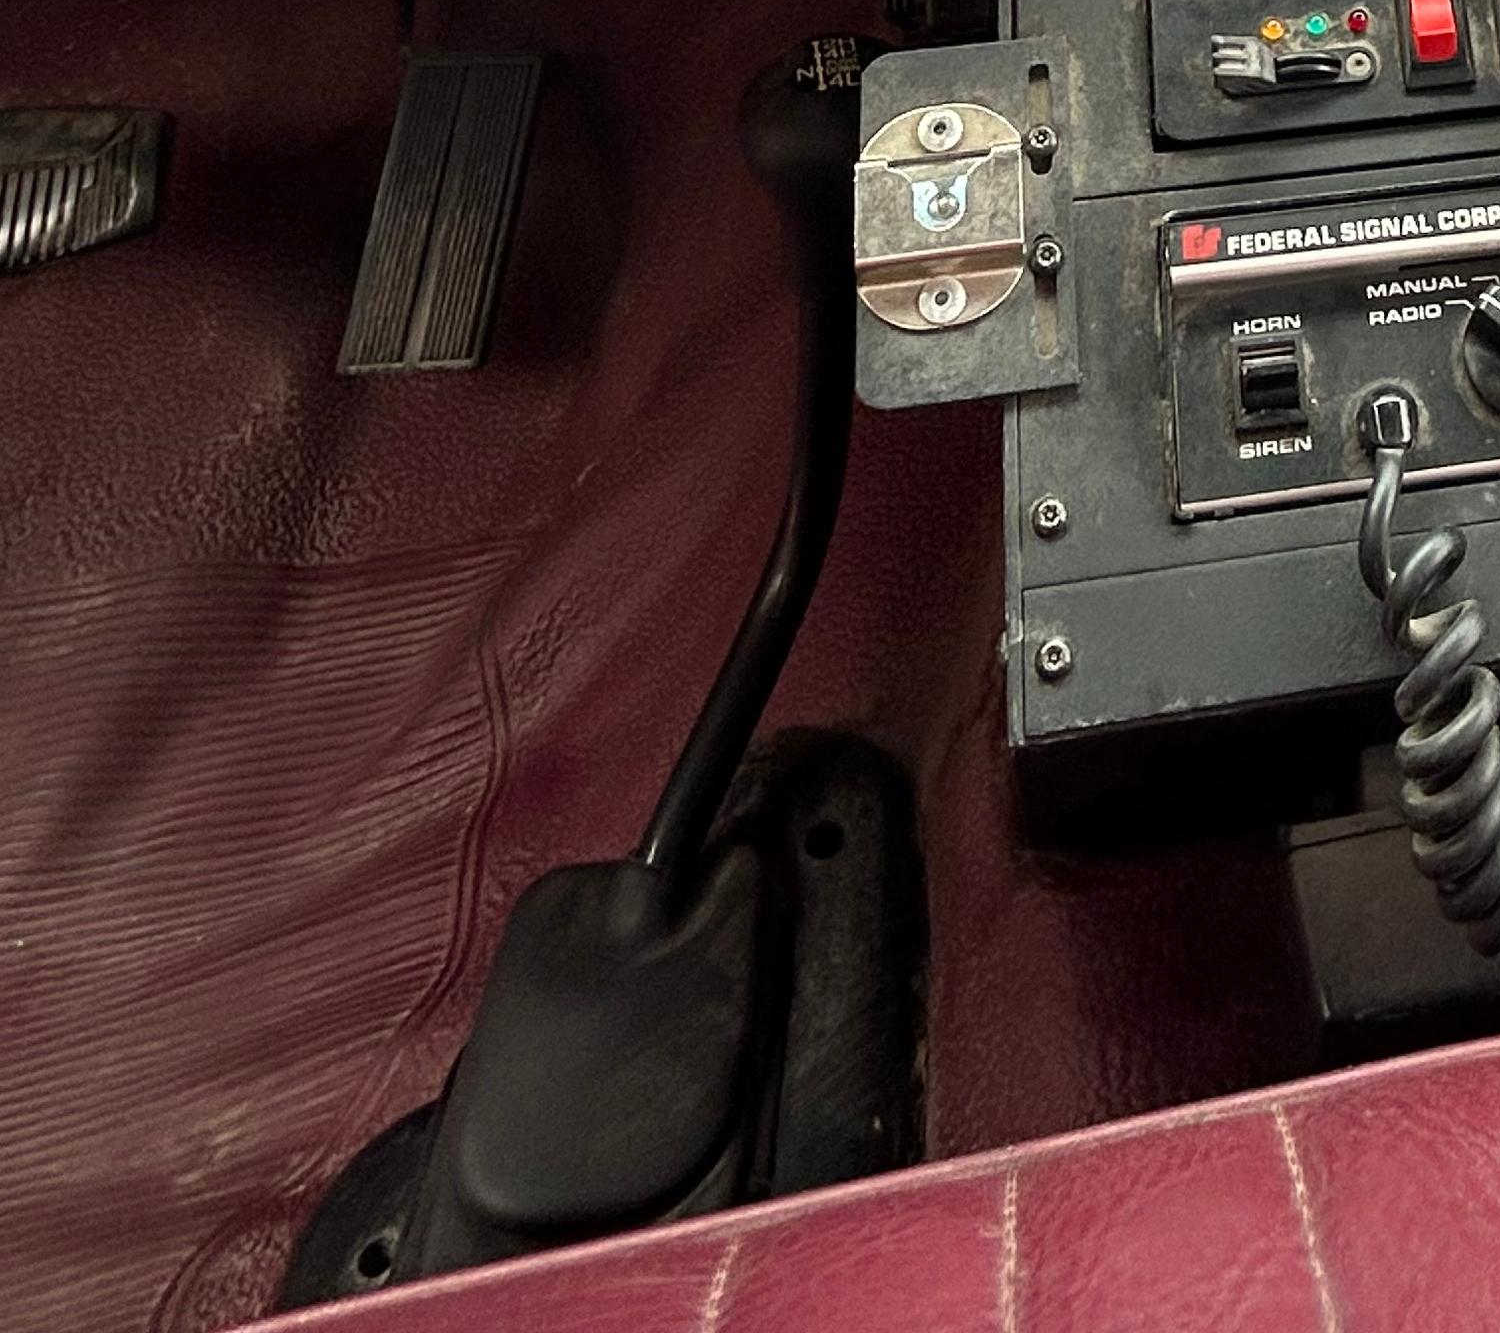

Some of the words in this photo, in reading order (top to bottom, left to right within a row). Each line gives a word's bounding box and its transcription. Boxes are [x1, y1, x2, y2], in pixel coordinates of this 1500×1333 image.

[796, 65, 815, 82] N
[1226, 222, 1336, 256] FEDERAL
[1339, 212, 1434, 242] SIGNAL
[1365, 274, 1468, 299] MANUAL
[1232, 314, 1302, 336] HORN
[1368, 303, 1443, 326] RADIO
[1239, 435, 1313, 460] SIREN
